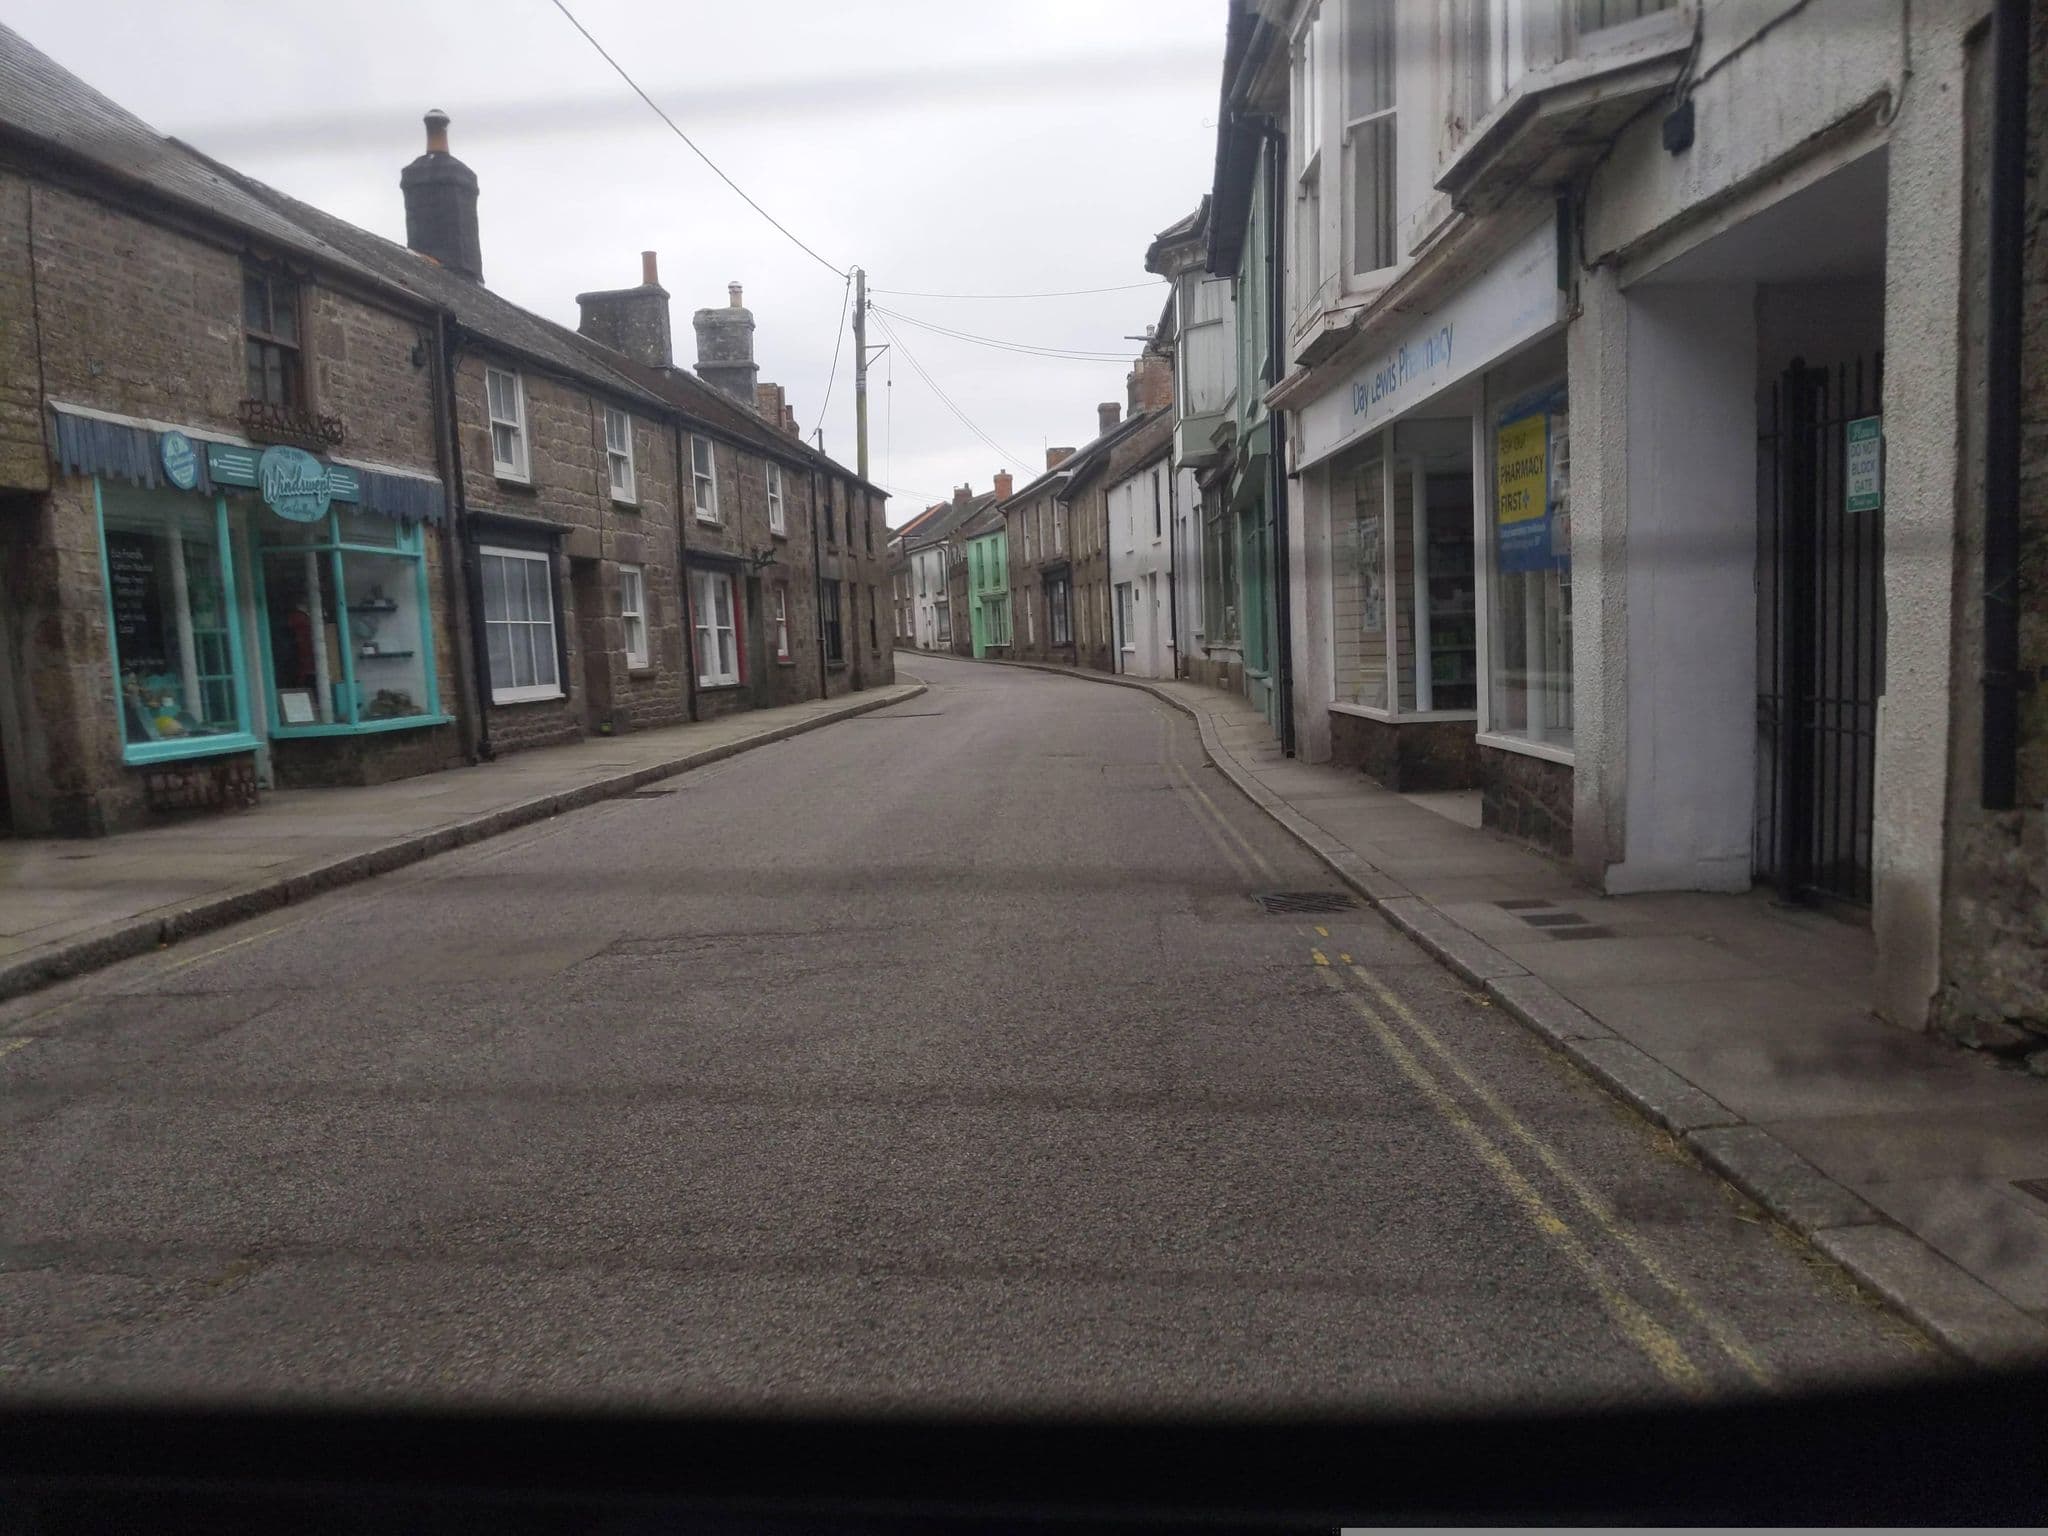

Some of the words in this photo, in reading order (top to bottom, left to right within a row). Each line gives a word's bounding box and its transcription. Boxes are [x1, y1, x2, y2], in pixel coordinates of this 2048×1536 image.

[1352, 381, 1369, 418] Day
[1371, 354, 1397, 404] Lewis
[263, 465, 332, 504] Windswept
[1500, 453, 1544, 484] PHARMACY
[1501, 491, 1521, 512] FIRST
